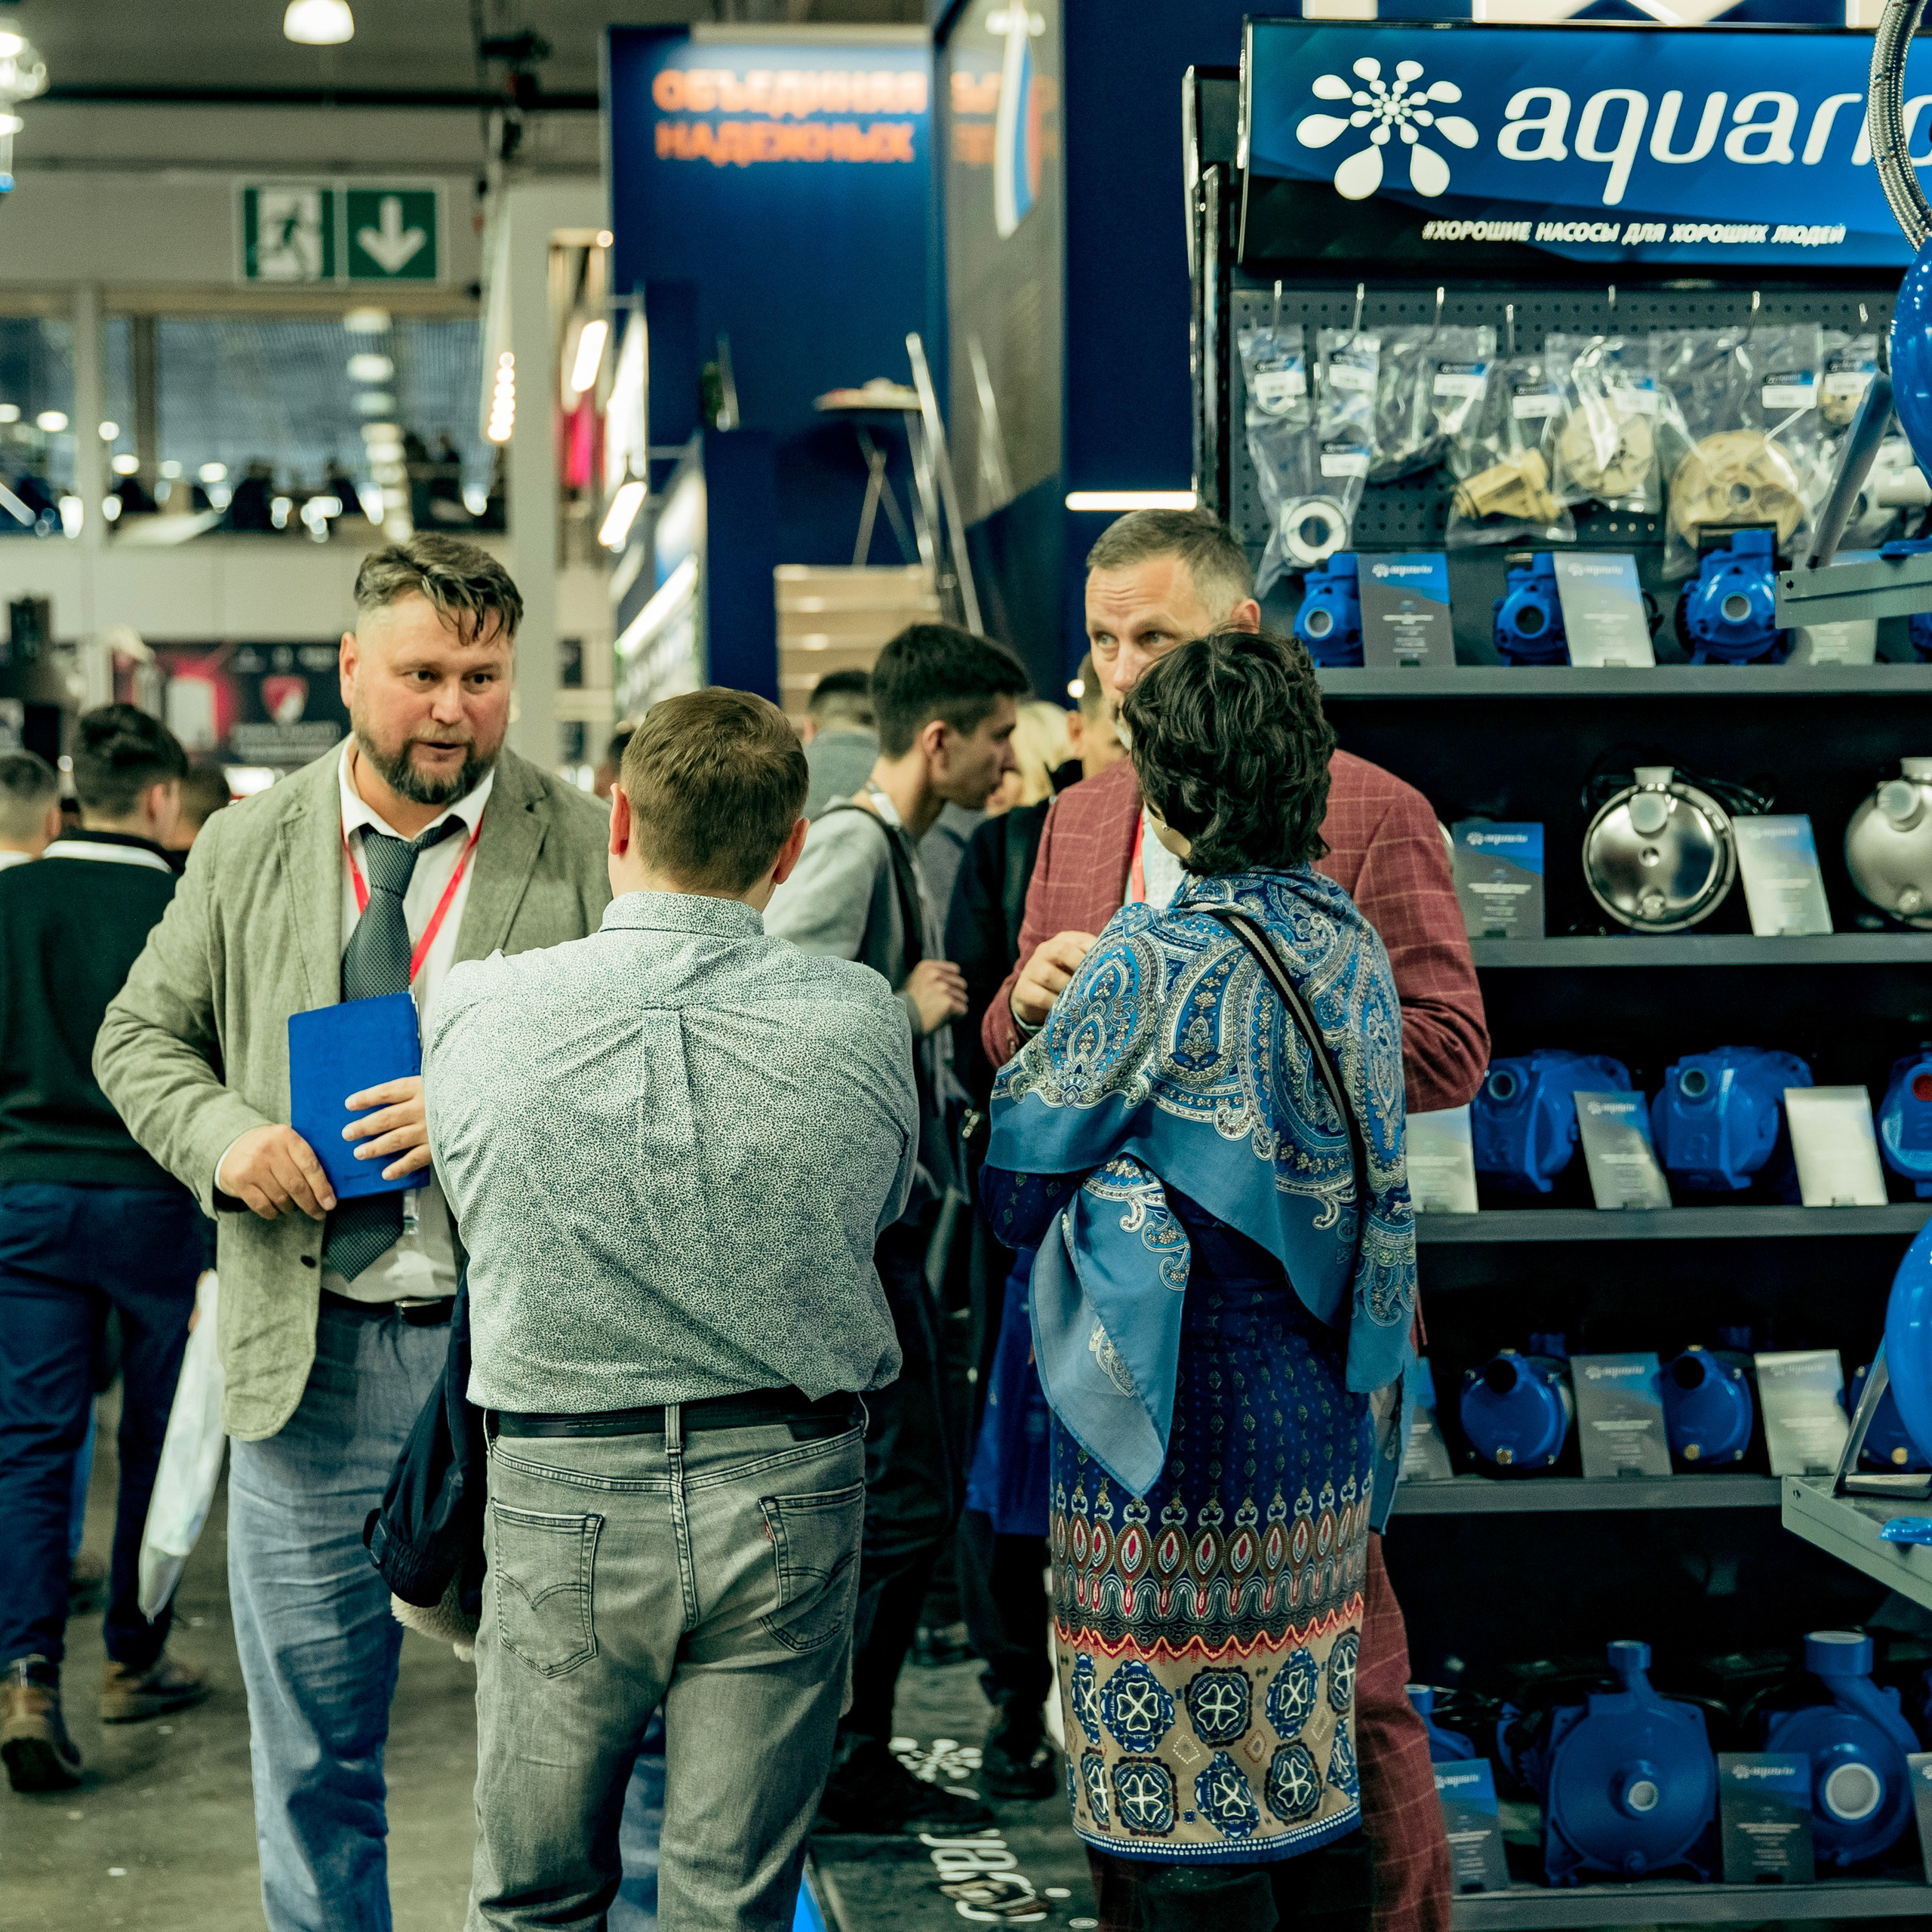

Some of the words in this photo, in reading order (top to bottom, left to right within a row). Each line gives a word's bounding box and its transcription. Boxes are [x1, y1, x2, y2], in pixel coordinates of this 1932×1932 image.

[1422, 220, 1532, 241] #ХОРОШИЕ
[1535, 222, 1620, 242] НАСОСЫ
[1621, 223, 1666, 245] ДЛЯ
[1669, 223, 1769, 244] ХОРОШИХ
[1770, 223, 1847, 248] ЛЮДЕЙ
